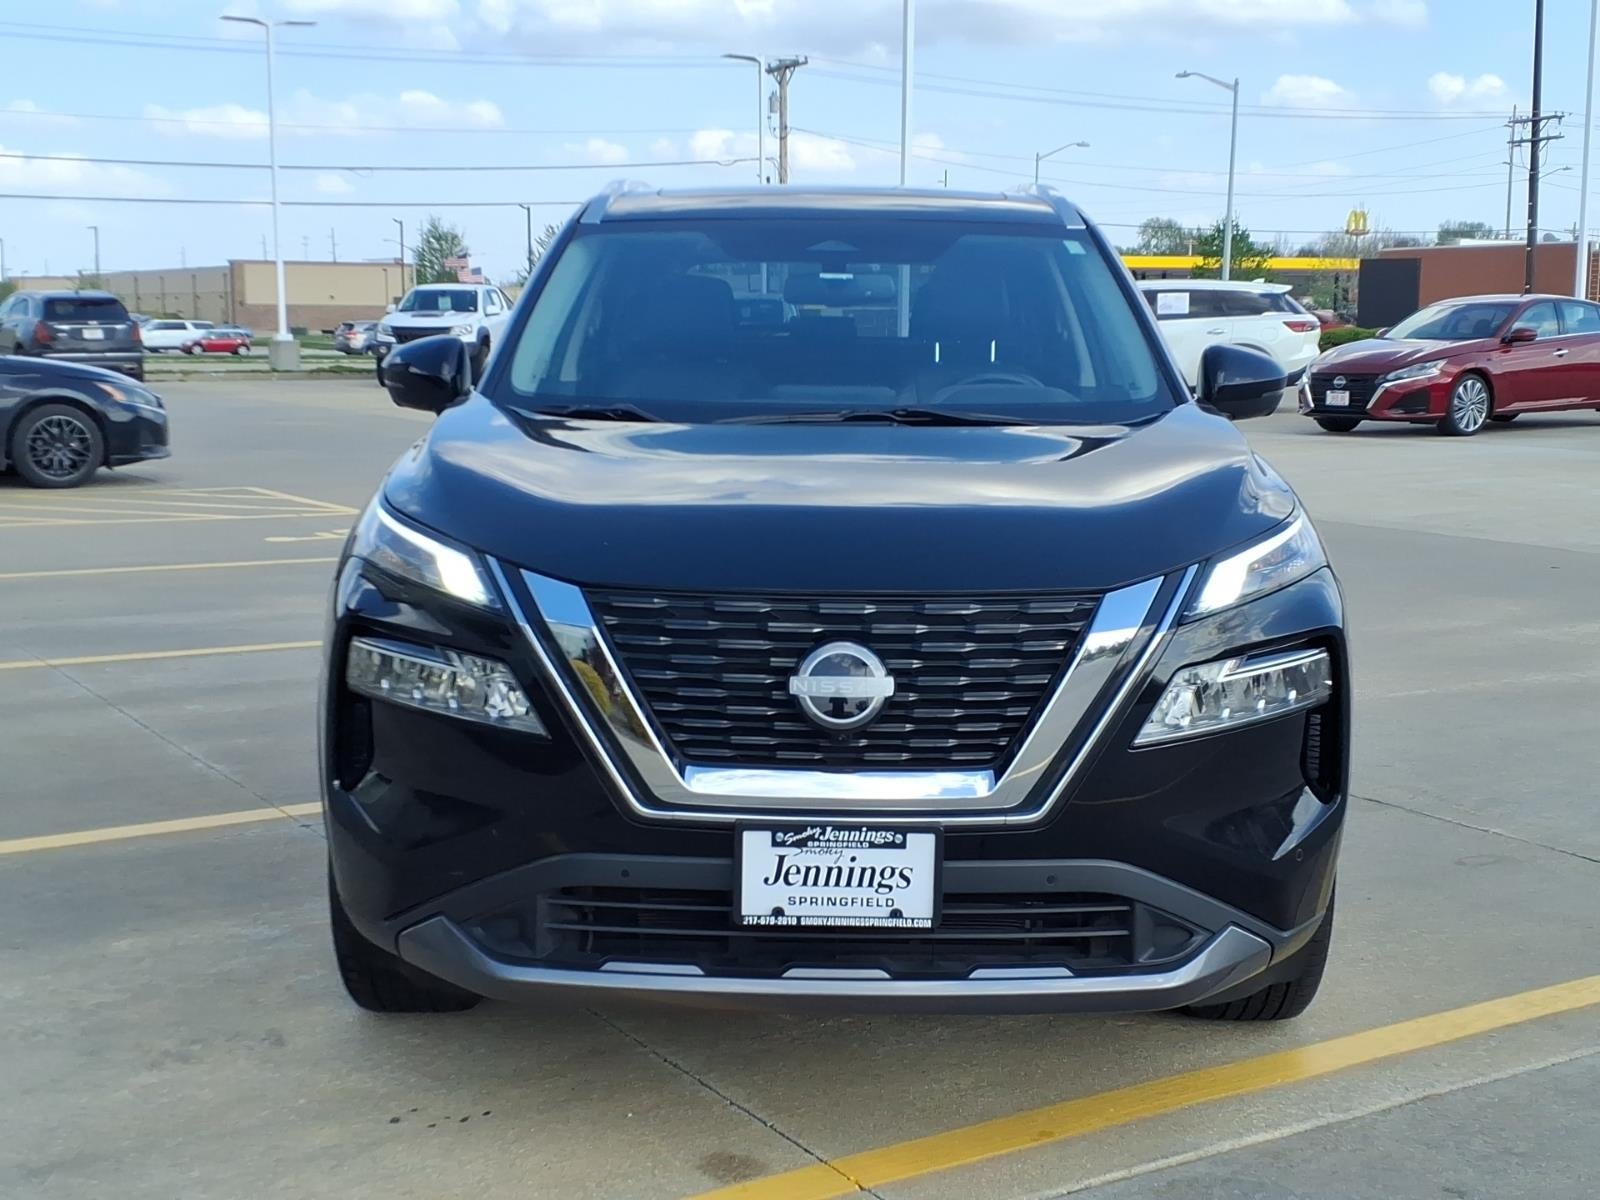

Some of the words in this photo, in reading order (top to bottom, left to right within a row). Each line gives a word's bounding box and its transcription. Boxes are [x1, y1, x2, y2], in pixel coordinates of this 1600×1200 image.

[793, 679, 891, 694] NISS
[784, 826, 822, 845] Smoky
[819, 826, 895, 844] Jennings
[807, 841, 869, 849] SPRINGFIELD
[763, 854, 913, 894] Jennings
[787, 896, 895, 908] SPRINGFIELD
